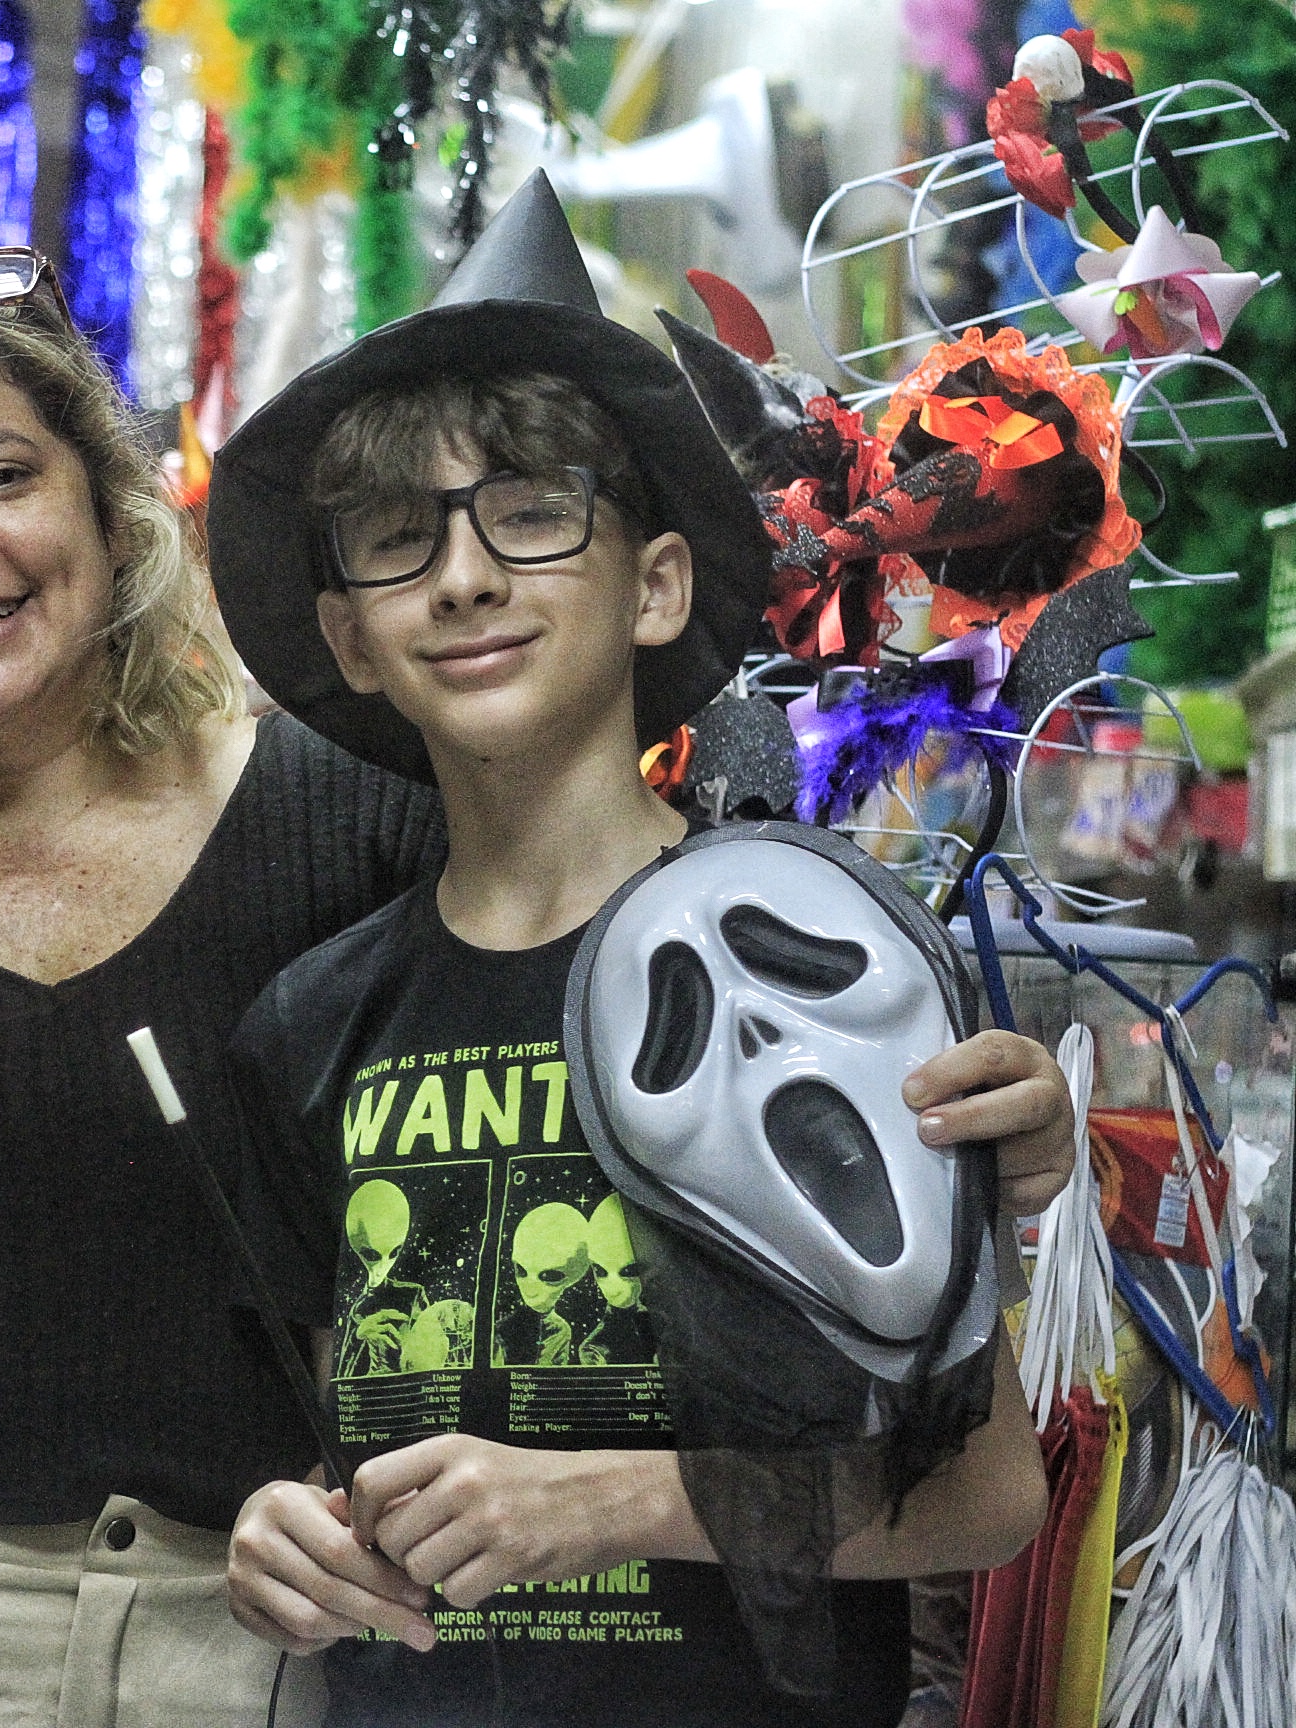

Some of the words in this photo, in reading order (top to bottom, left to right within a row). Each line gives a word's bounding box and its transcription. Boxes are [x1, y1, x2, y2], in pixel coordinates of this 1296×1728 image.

[354, 1058, 392, 1084] KNOWN
[398, 1055, 416, 1070] AS
[424, 1051, 449, 1067] THE
[454, 1046, 491, 1062] BEST
[498, 1041, 560, 1060] PLAYERS
[343, 1061, 569, 1165] WANT
[645, 1370, 662, 1379] Unk
[439, 1415, 460, 1423] Black
[628, 1412, 649, 1422] Deep
[509, 1423, 540, 1433] Ranking
[340, 1433, 368, 1443] Ranking
[538, 1611, 582, 1624] PLEASE
[589, 1611, 662, 1625] CONTACT
[503, 1627, 522, 1640] OF
[528, 1627, 562, 1640] VIDEO
[568, 1627, 607, 1641] GAME
[615, 1627, 683, 1641] PLAYERS
